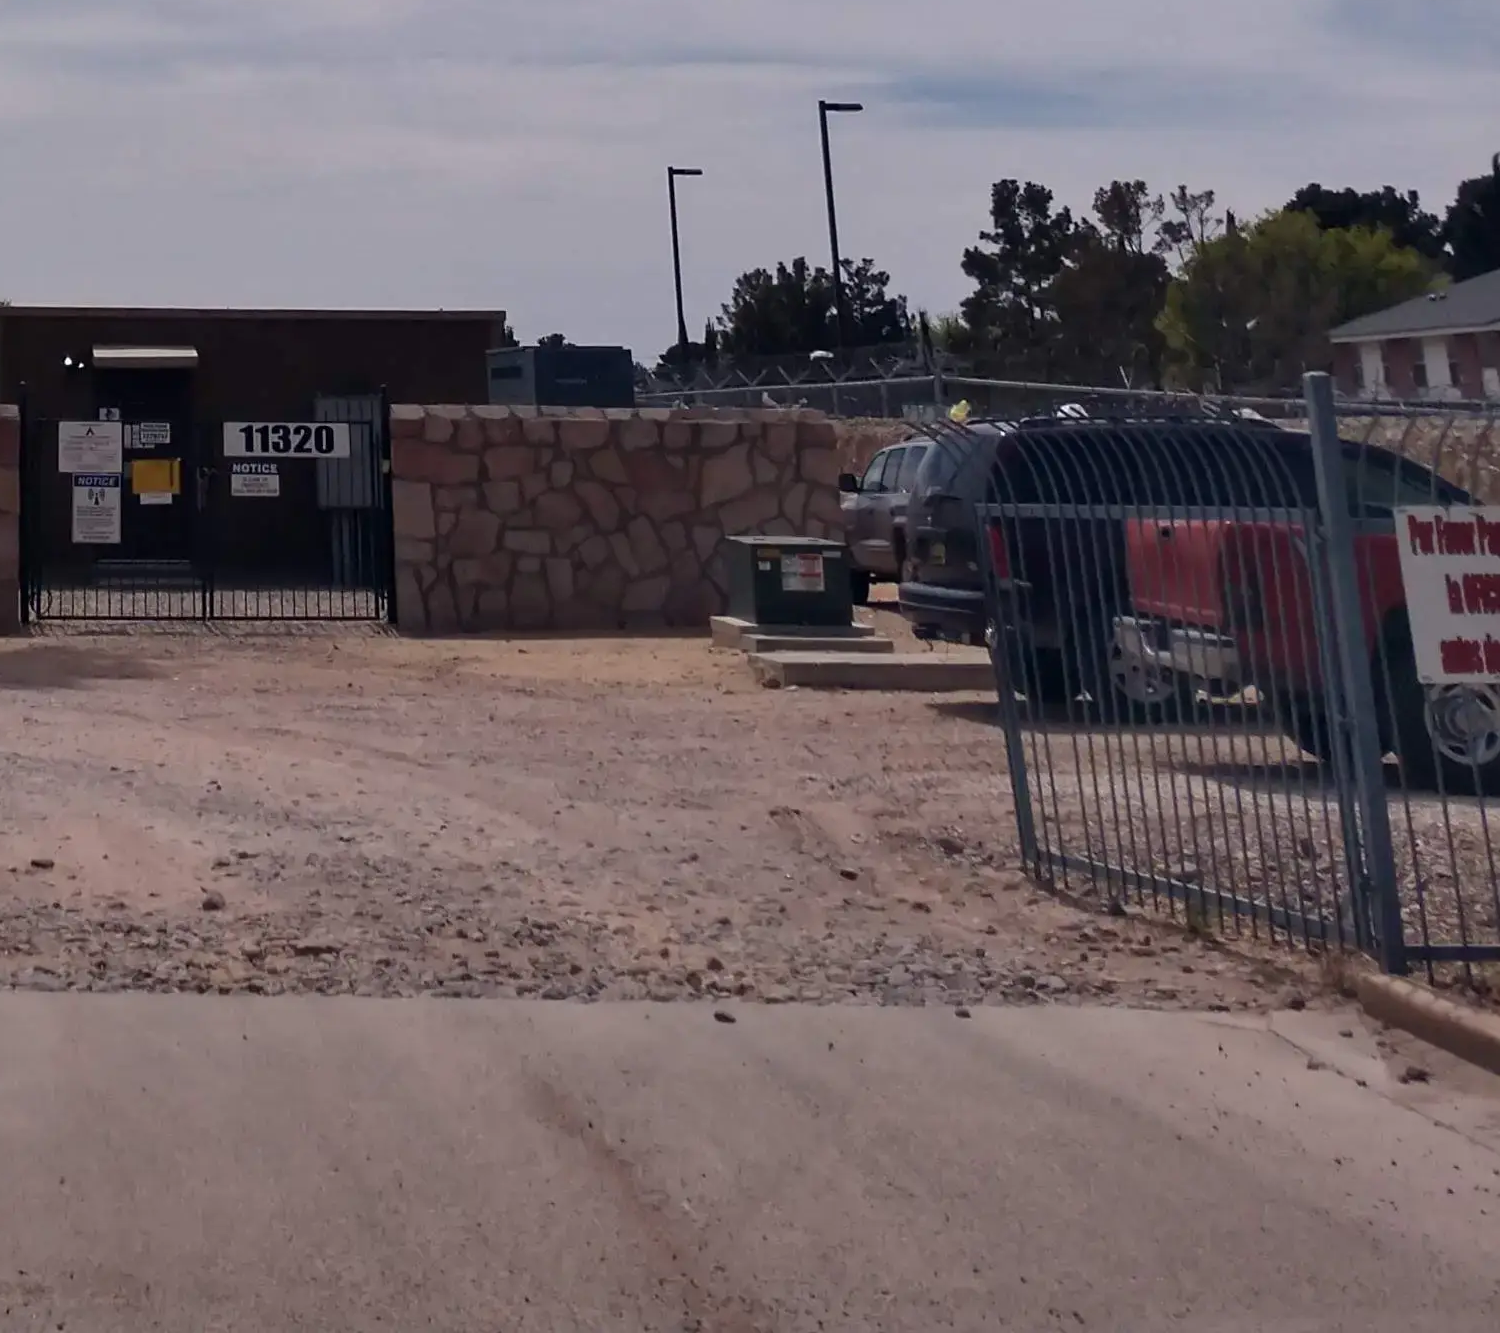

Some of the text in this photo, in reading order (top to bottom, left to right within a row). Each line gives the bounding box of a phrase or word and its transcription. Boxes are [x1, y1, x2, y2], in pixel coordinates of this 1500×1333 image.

[239, 424, 335, 454] 11320
[232, 463, 278, 474] NOTICE
[77, 476, 117, 486] NOTICE
